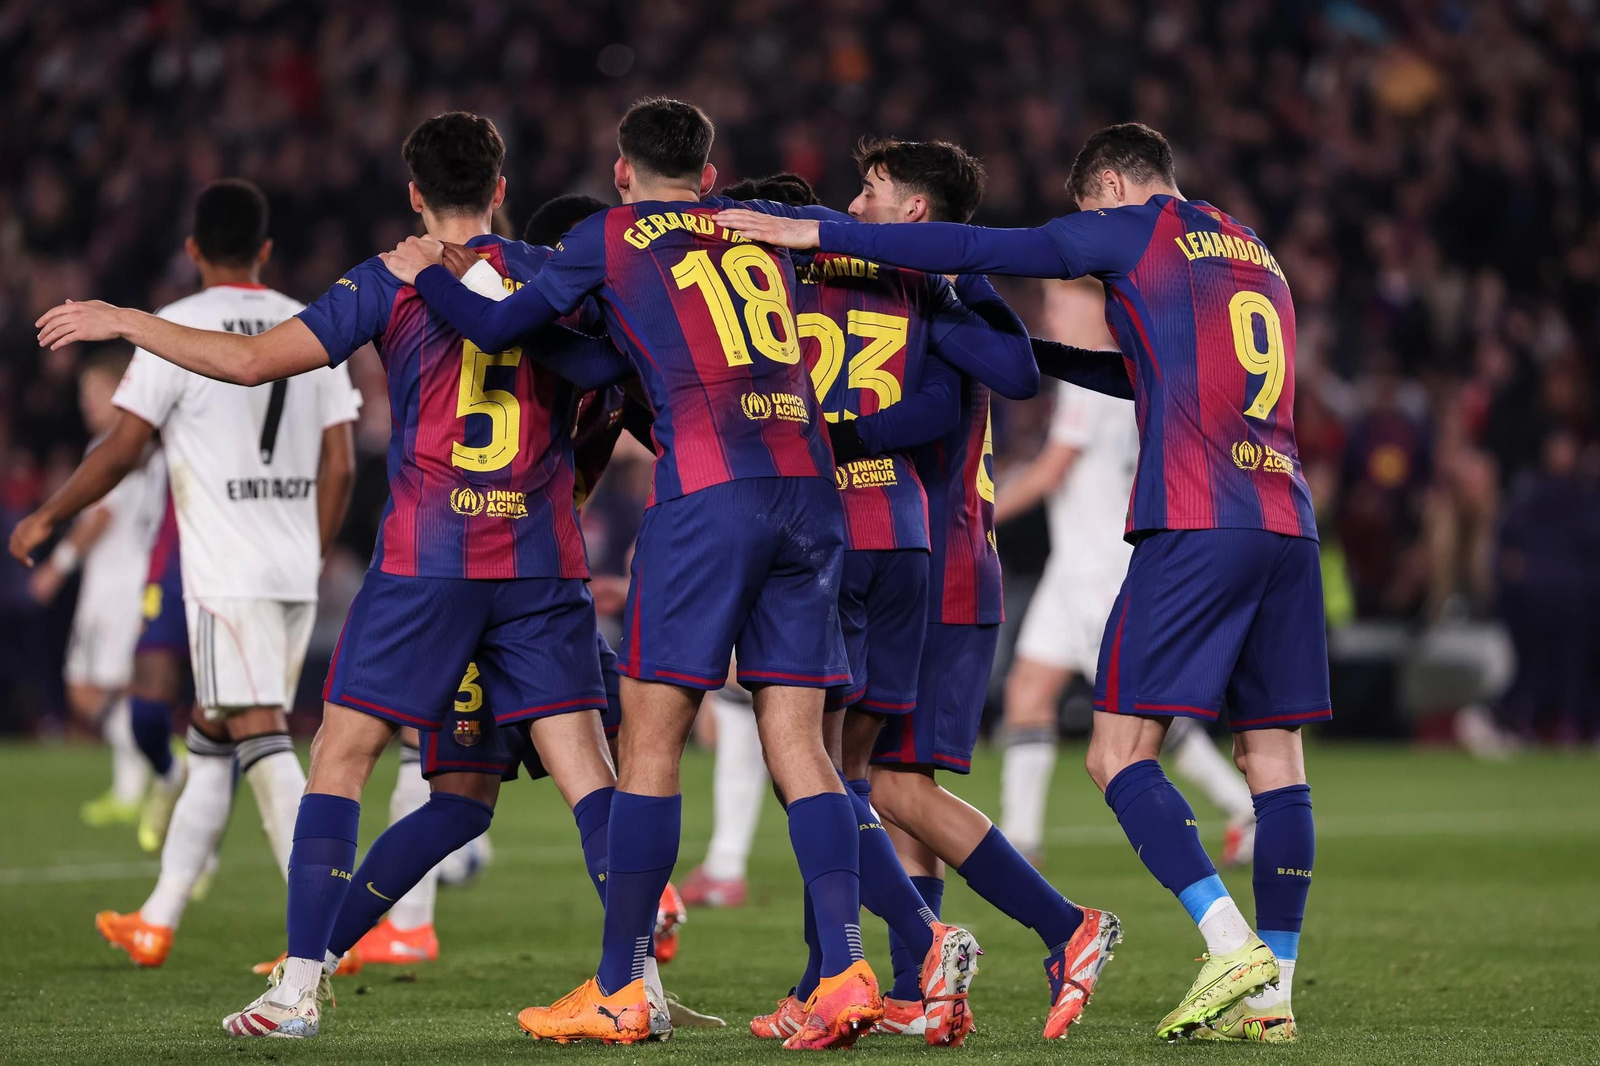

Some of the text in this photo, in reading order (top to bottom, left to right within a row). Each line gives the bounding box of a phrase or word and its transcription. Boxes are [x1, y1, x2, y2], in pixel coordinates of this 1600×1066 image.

[624, 212, 715, 250] GERARD
[1174, 231, 1286, 283] LEWANDOWS
[671, 244, 801, 367] 18
[796, 309, 909, 424] 23
[1228, 290, 1286, 420] 9
[451, 338, 523, 473] 5
[771, 392, 806, 409] UNHCR
[776, 404, 809, 420] ACNUR
[847, 458, 894, 473] UNHCR
[852, 470, 896, 485] ACNUR
[454, 662, 483, 713] 3
[1277, 867, 1312, 878] BARÇA
